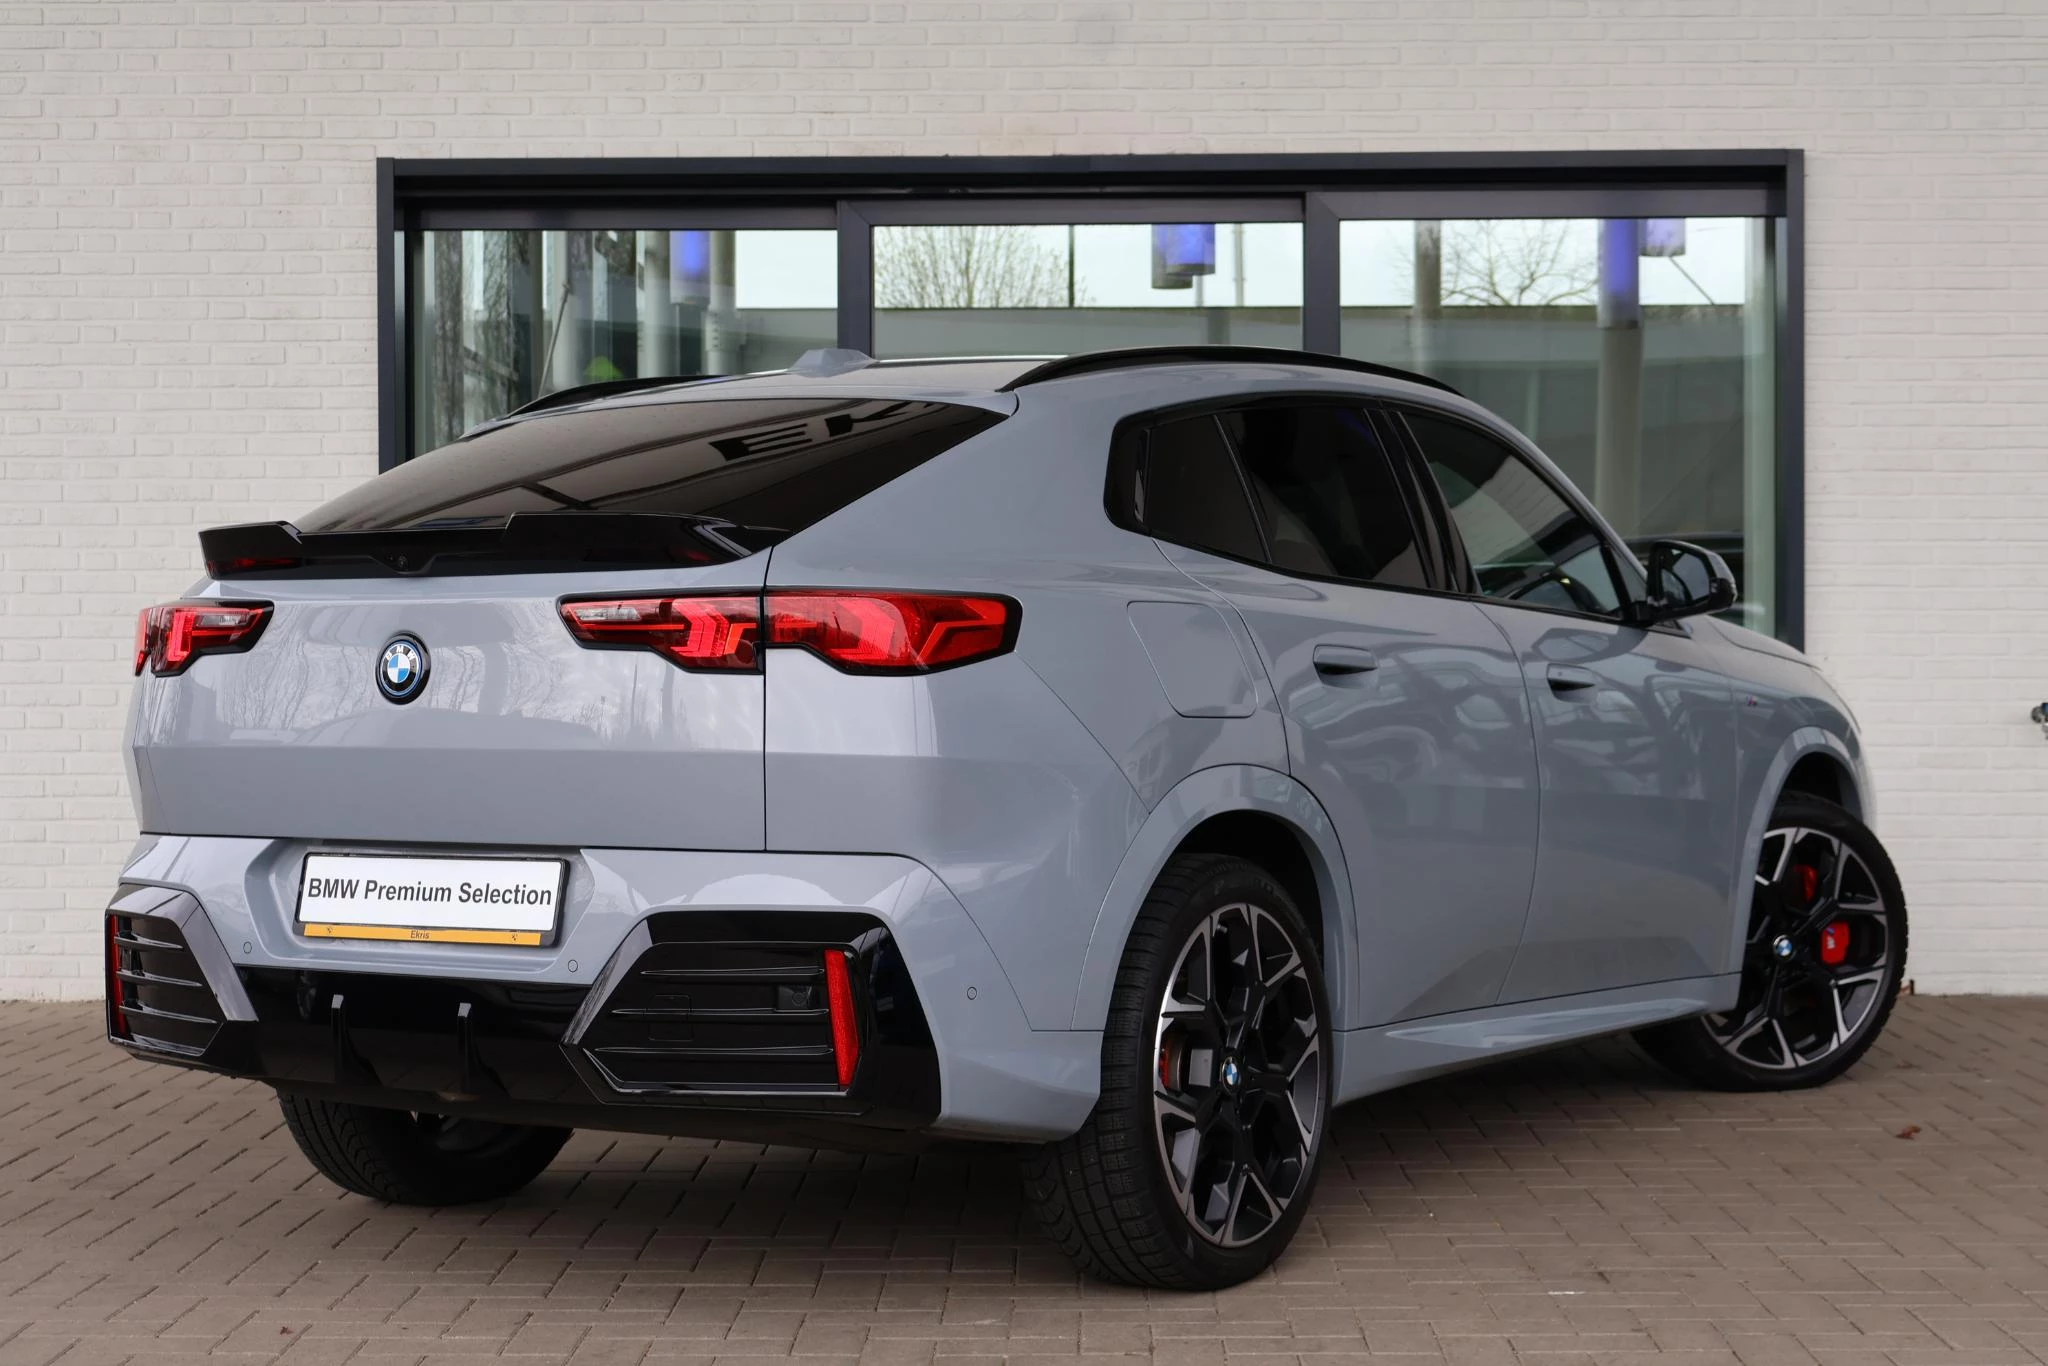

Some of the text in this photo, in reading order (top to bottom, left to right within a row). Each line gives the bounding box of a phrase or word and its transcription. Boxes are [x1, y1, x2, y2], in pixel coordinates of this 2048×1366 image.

[385, 645, 417, 661] BMW
[307, 878, 552, 906] BMW Premium Selection
[410, 929, 430, 939] Ekris
